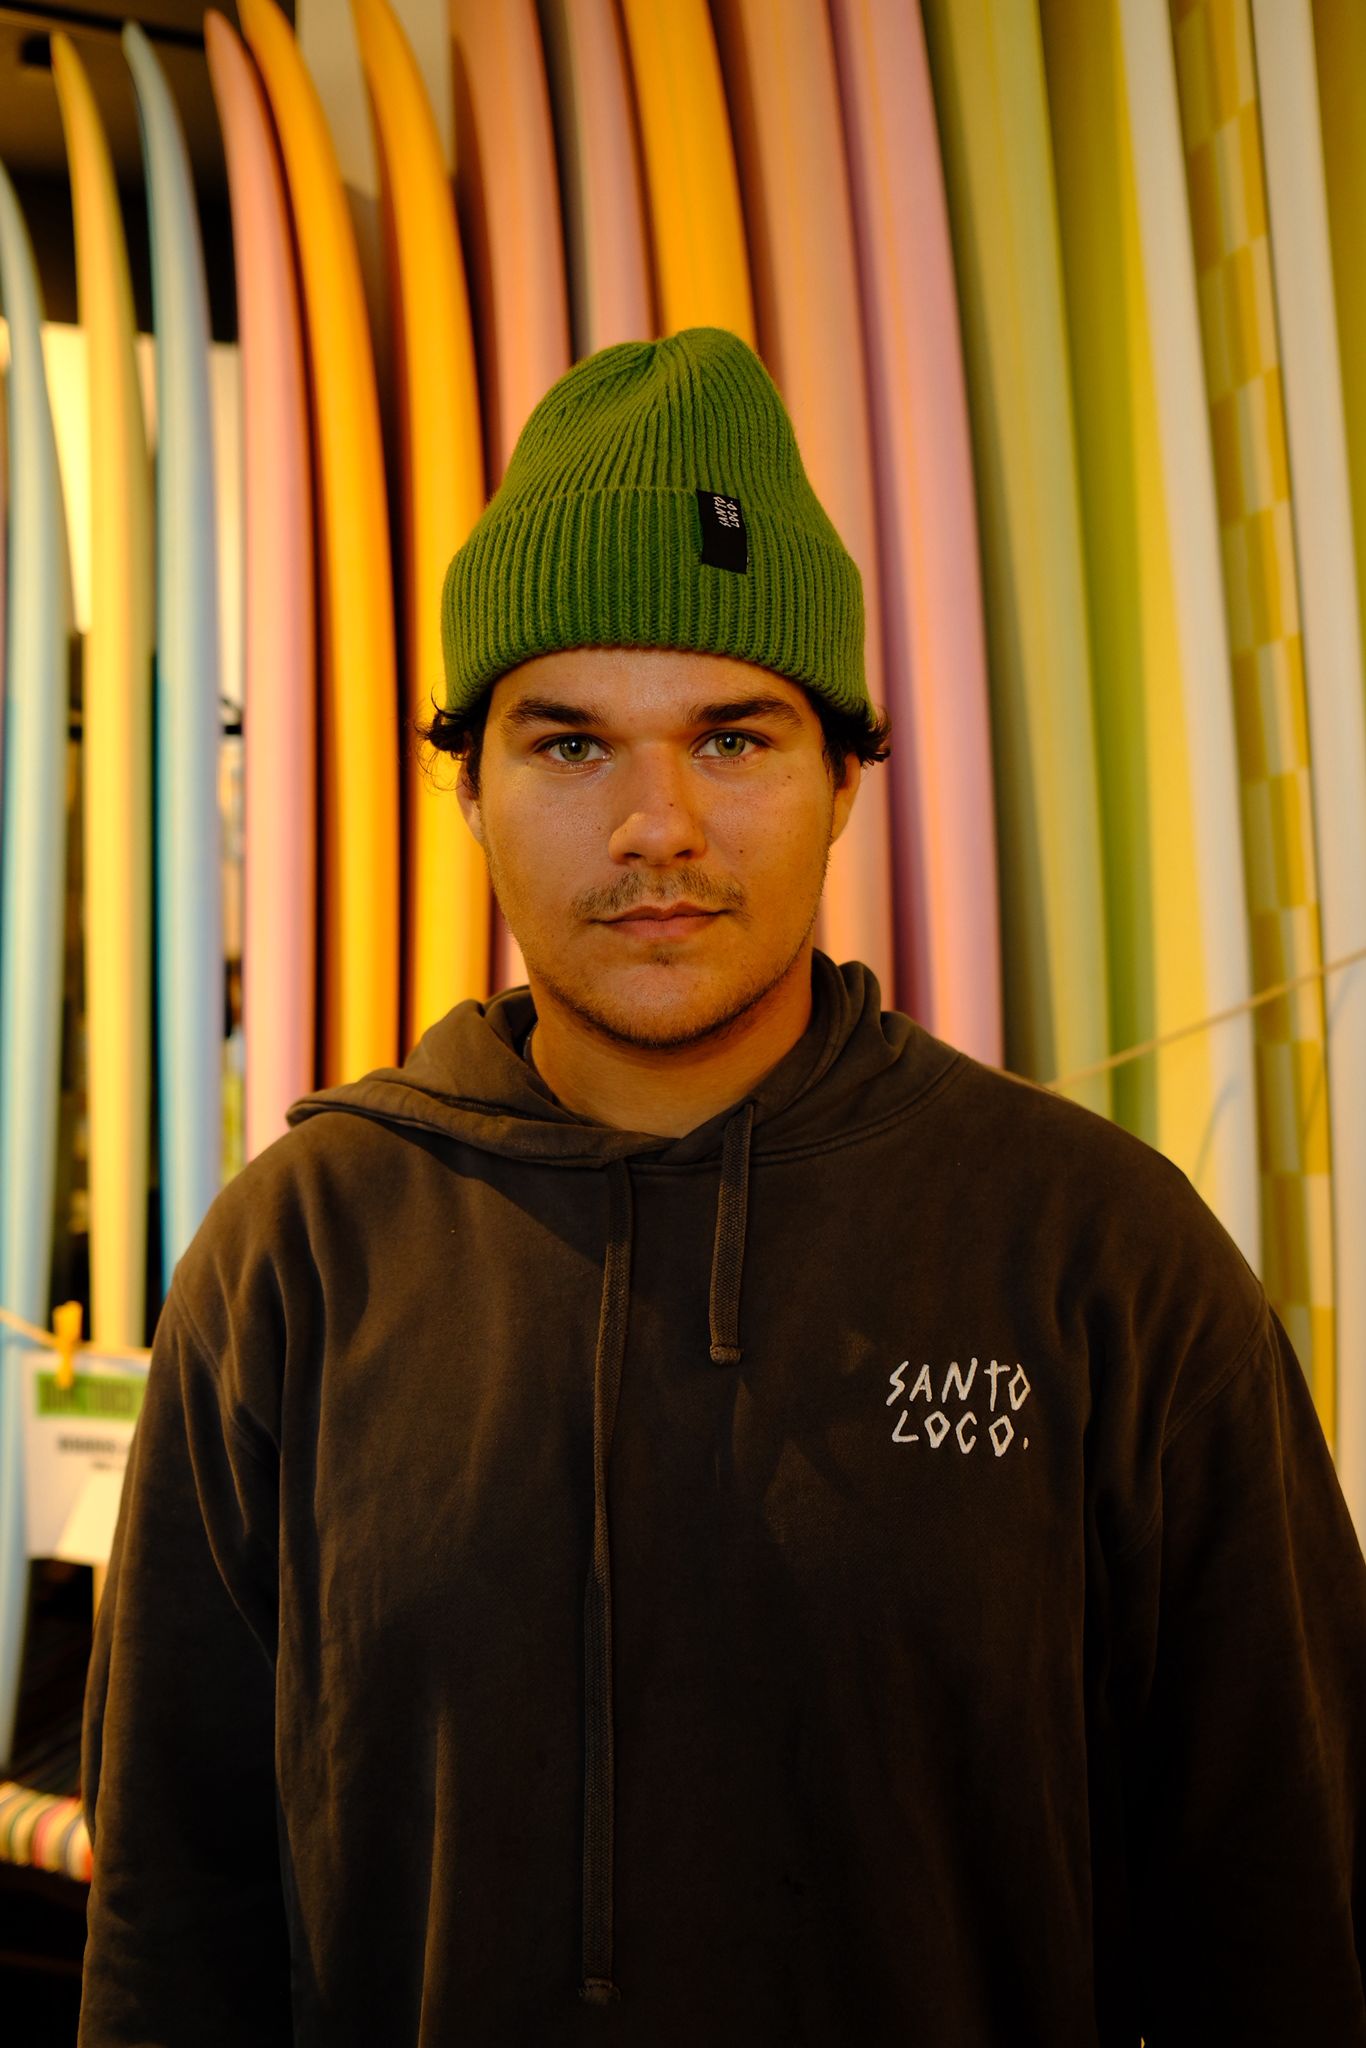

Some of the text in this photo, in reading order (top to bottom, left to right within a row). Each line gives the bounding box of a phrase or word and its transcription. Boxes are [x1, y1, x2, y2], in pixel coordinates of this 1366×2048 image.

[713, 496, 732, 528] SANTO
[886, 1357, 1031, 1412] SANTO
[892, 1410, 1029, 1457] LOCO.
